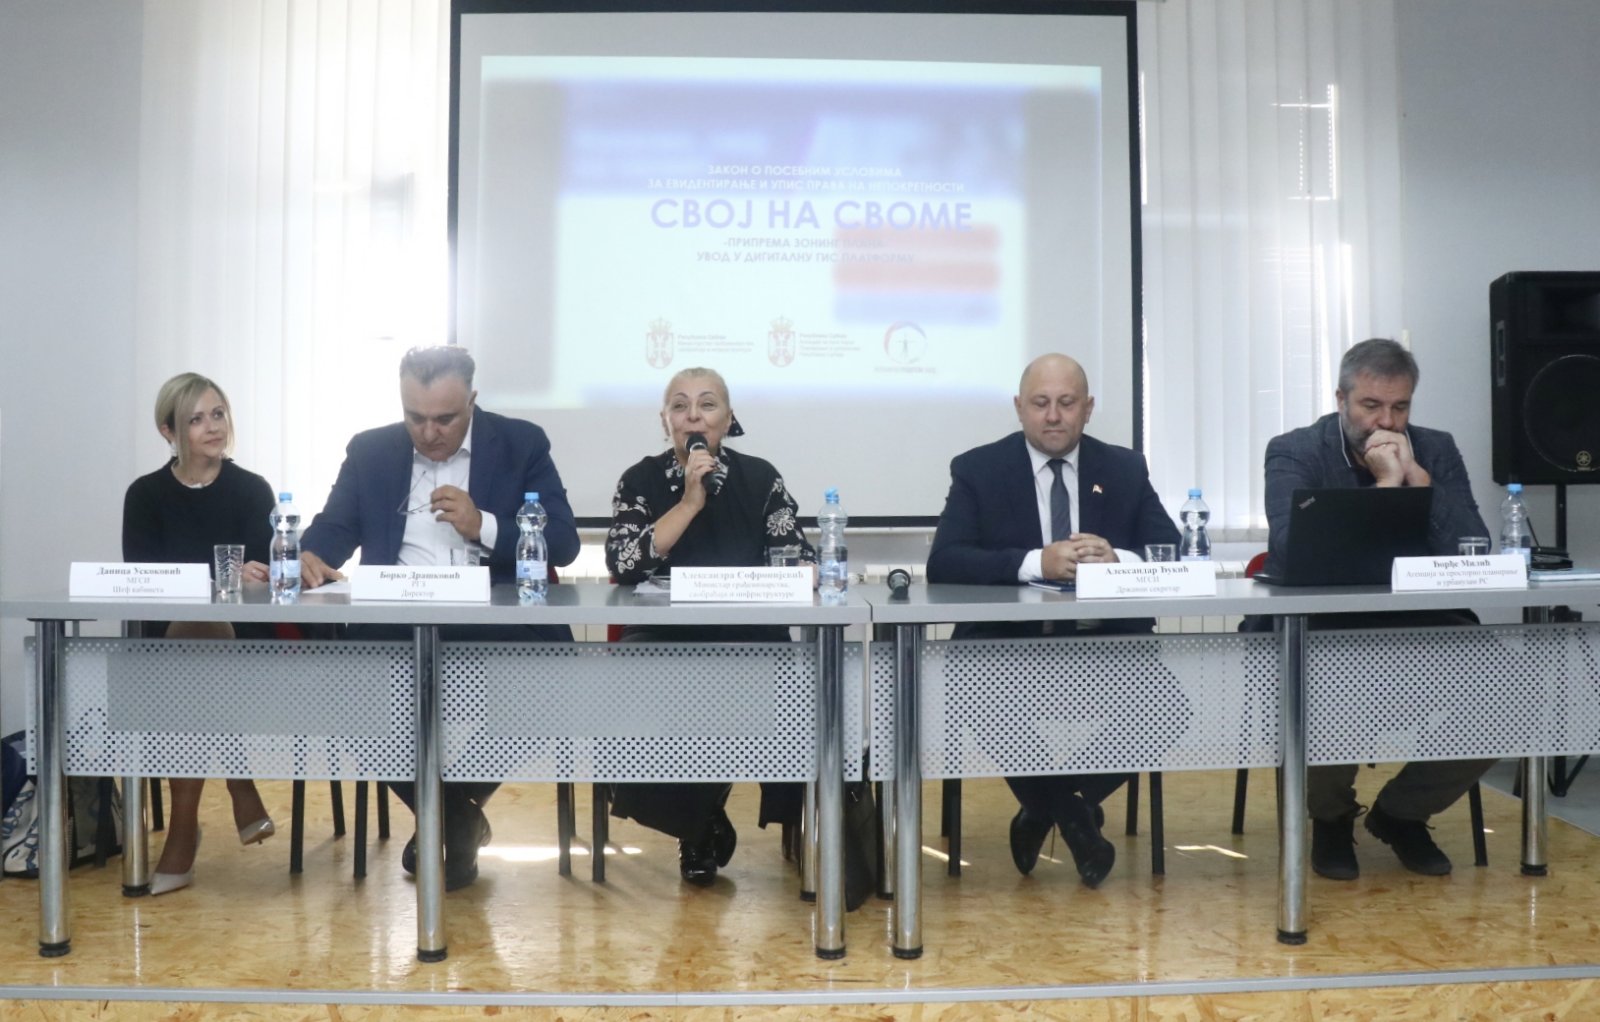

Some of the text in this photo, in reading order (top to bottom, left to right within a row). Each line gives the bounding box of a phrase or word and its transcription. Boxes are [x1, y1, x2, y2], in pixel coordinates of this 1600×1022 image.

[707, 164, 903, 178] ЗАКОН О ПОСЕБНИМ УСЛОВИМА
[647, 178, 664, 190] ЗА
[666, 178, 758, 191] ЕВИДЕНТИРАЊЕ
[759, 179, 769, 190] И
[770, 179, 805, 191] УПИС
[806, 179, 846, 192] ПРАВА
[848, 180, 866, 192] НА
[650, 198, 973, 232] СВОЈ НА СВОМЕ
[793, 238, 839, 249] ЗОНИНГ
[696, 251, 731, 264] УВОД
[733, 251, 742, 264] У
[743, 252, 813, 264] ДИГИТАЛНУ
[815, 252, 840, 264] ГИС
[1433, 559, 1491, 570] Ђорђе Милић
[96, 566, 182, 577] Даница Ускоковић
[379, 571, 461, 581] Борко Драшковић
[1105, 566, 1159, 577] Александар
